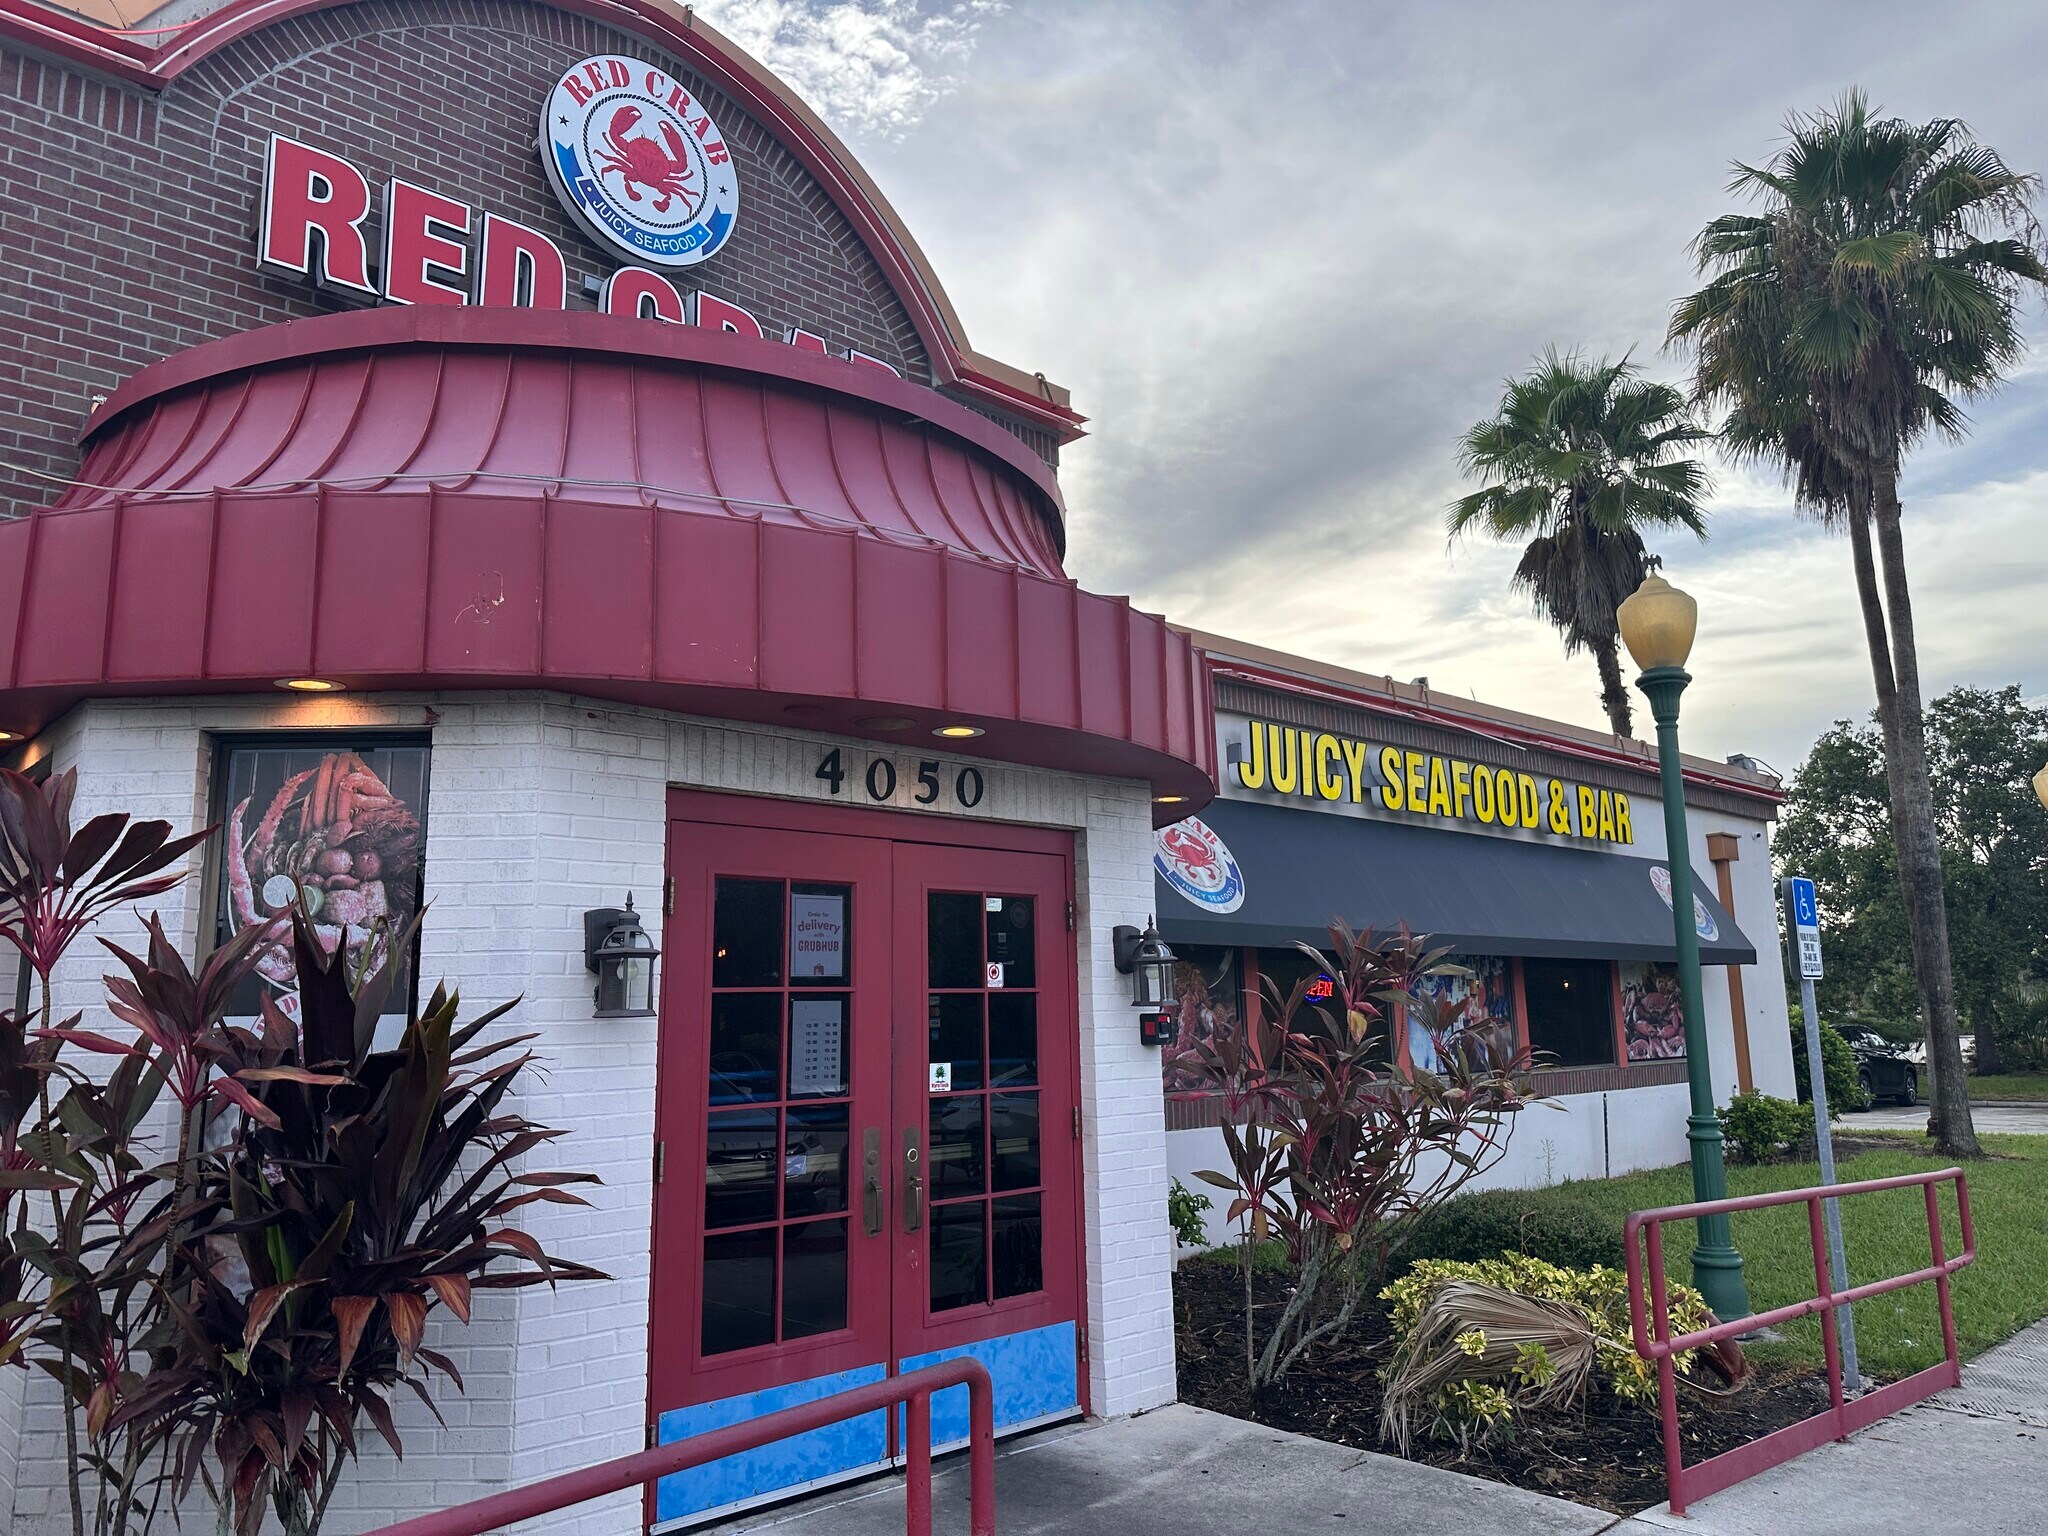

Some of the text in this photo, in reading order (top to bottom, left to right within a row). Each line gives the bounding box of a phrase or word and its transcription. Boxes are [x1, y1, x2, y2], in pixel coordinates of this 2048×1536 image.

[562, 59, 729, 166] RED CRAB
[260, 131, 567, 311] RED
[592, 199, 697, 252] JUICY SEAFOOD
[815, 747, 984, 808] 4050
[1237, 719, 1635, 845] JUICY SEAFOOD & BAR
[1181, 882, 1235, 902] JUICY SEAFOOD
[797, 919, 841, 935] delivery
[798, 940, 839, 952] GRUBHUB
